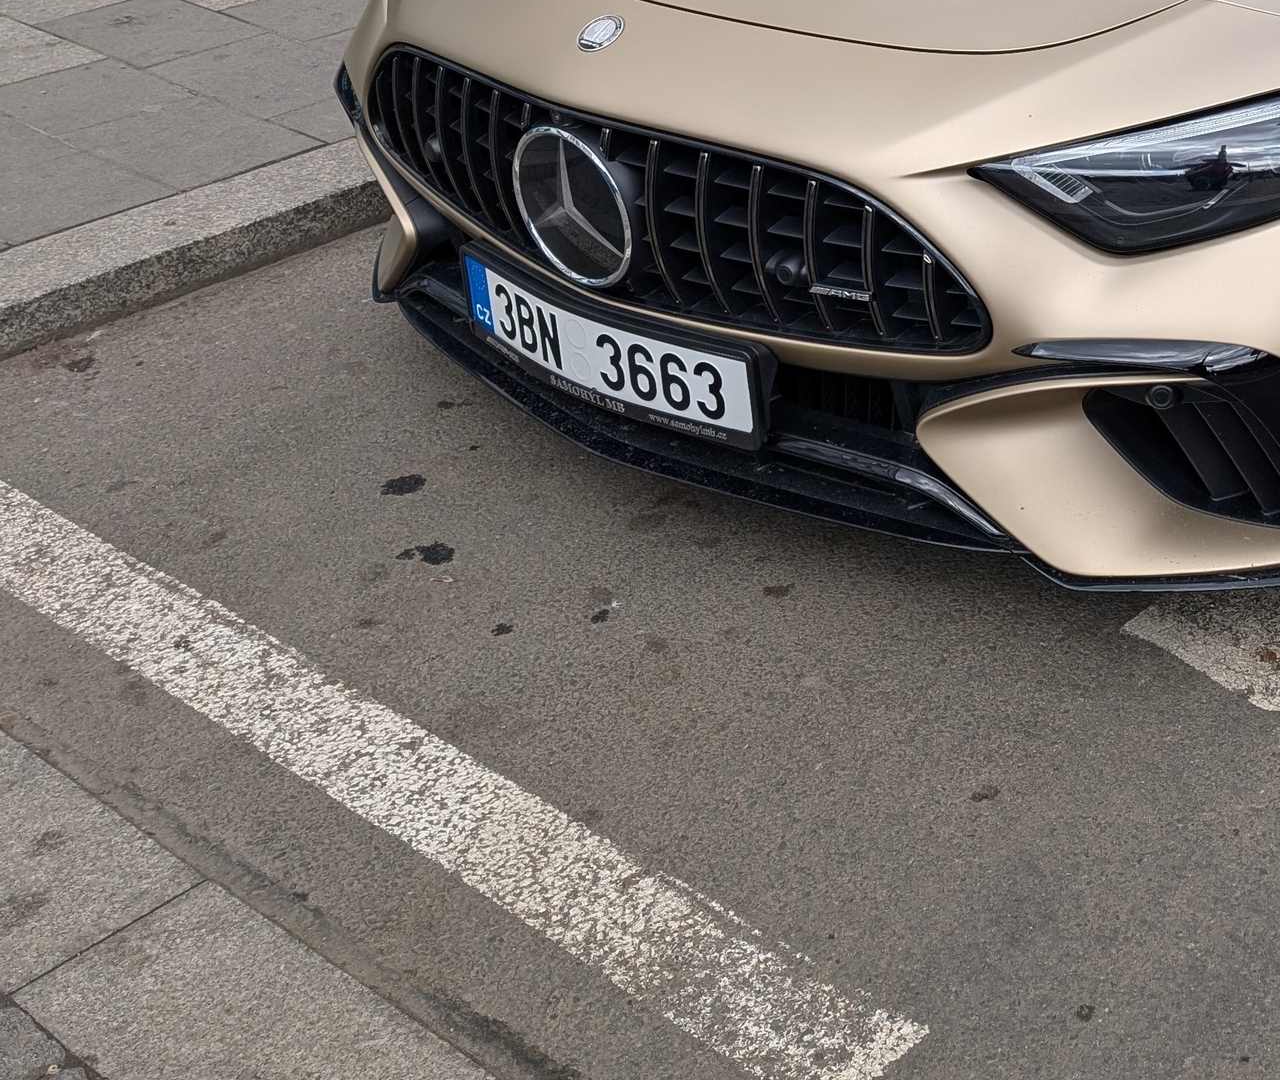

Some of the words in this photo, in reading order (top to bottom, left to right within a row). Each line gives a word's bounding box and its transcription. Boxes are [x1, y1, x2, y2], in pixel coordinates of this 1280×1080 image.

[476, 303, 491, 325] CZ
[495, 284, 563, 370] 3BN
[596, 333, 725, 420] 3663
[605, 398, 625, 413] MB
[648, 412, 727, 440] www.samohylmb.cz
